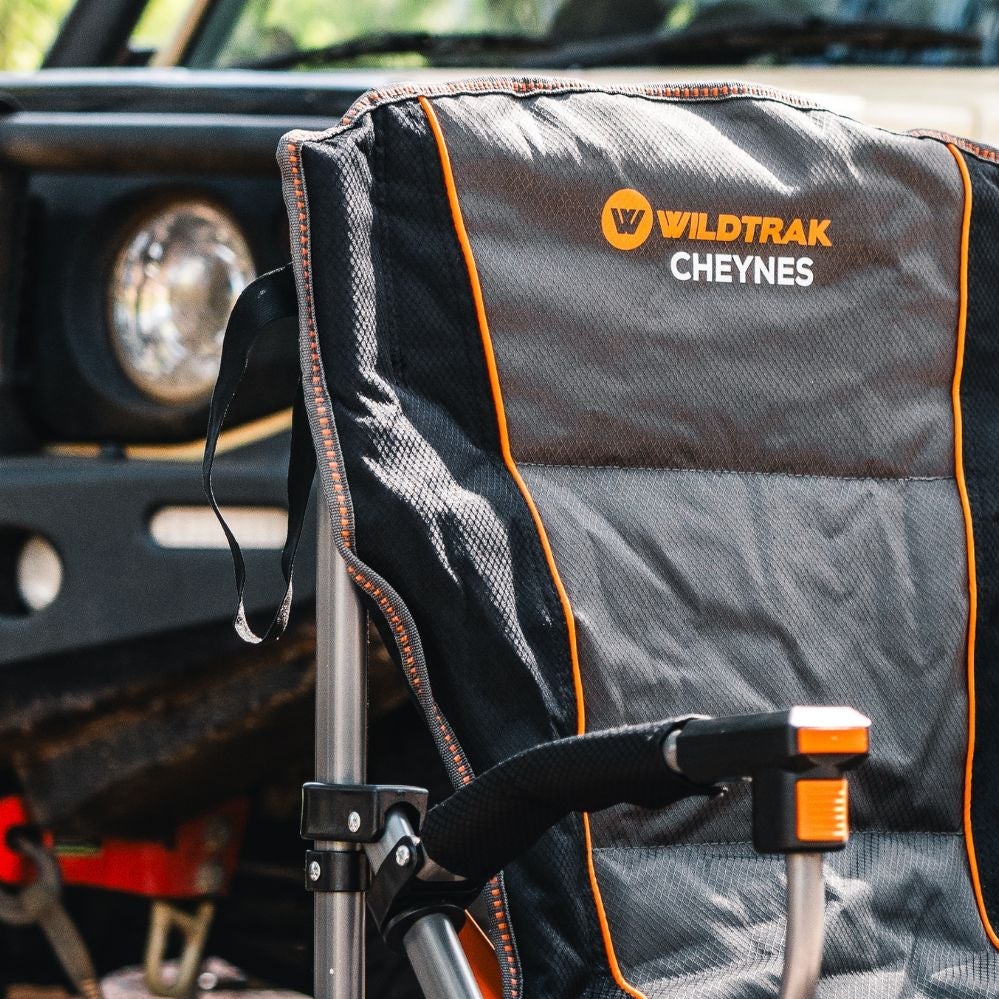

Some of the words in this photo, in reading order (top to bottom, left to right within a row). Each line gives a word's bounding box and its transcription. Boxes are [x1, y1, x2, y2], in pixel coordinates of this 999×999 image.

[610, 208, 646, 236] W
[656, 210, 833, 247] WILDTRAK
[670, 251, 814, 287] CHEYNES
